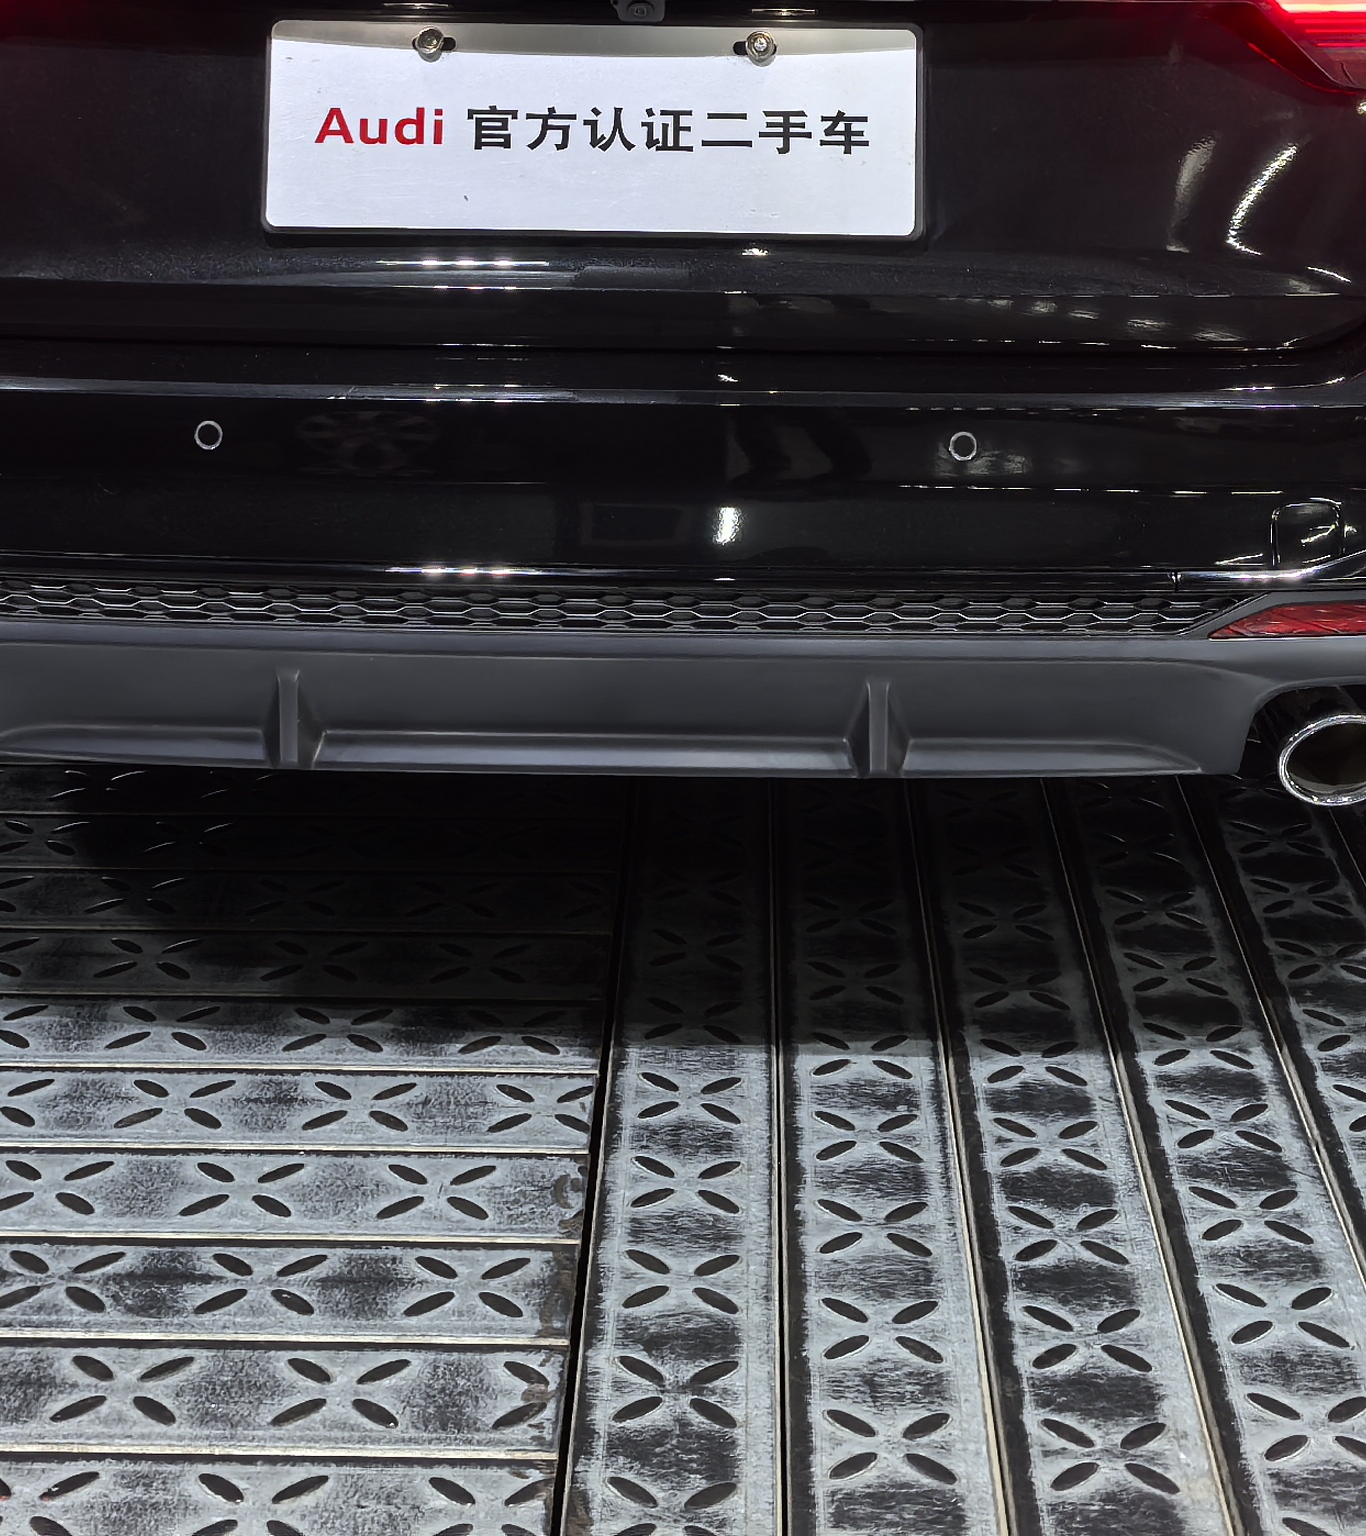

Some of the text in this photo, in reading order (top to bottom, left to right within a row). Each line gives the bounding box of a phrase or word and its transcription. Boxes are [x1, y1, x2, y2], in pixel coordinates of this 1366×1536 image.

[315, 104, 871, 156] Audi 官方认证二手车
